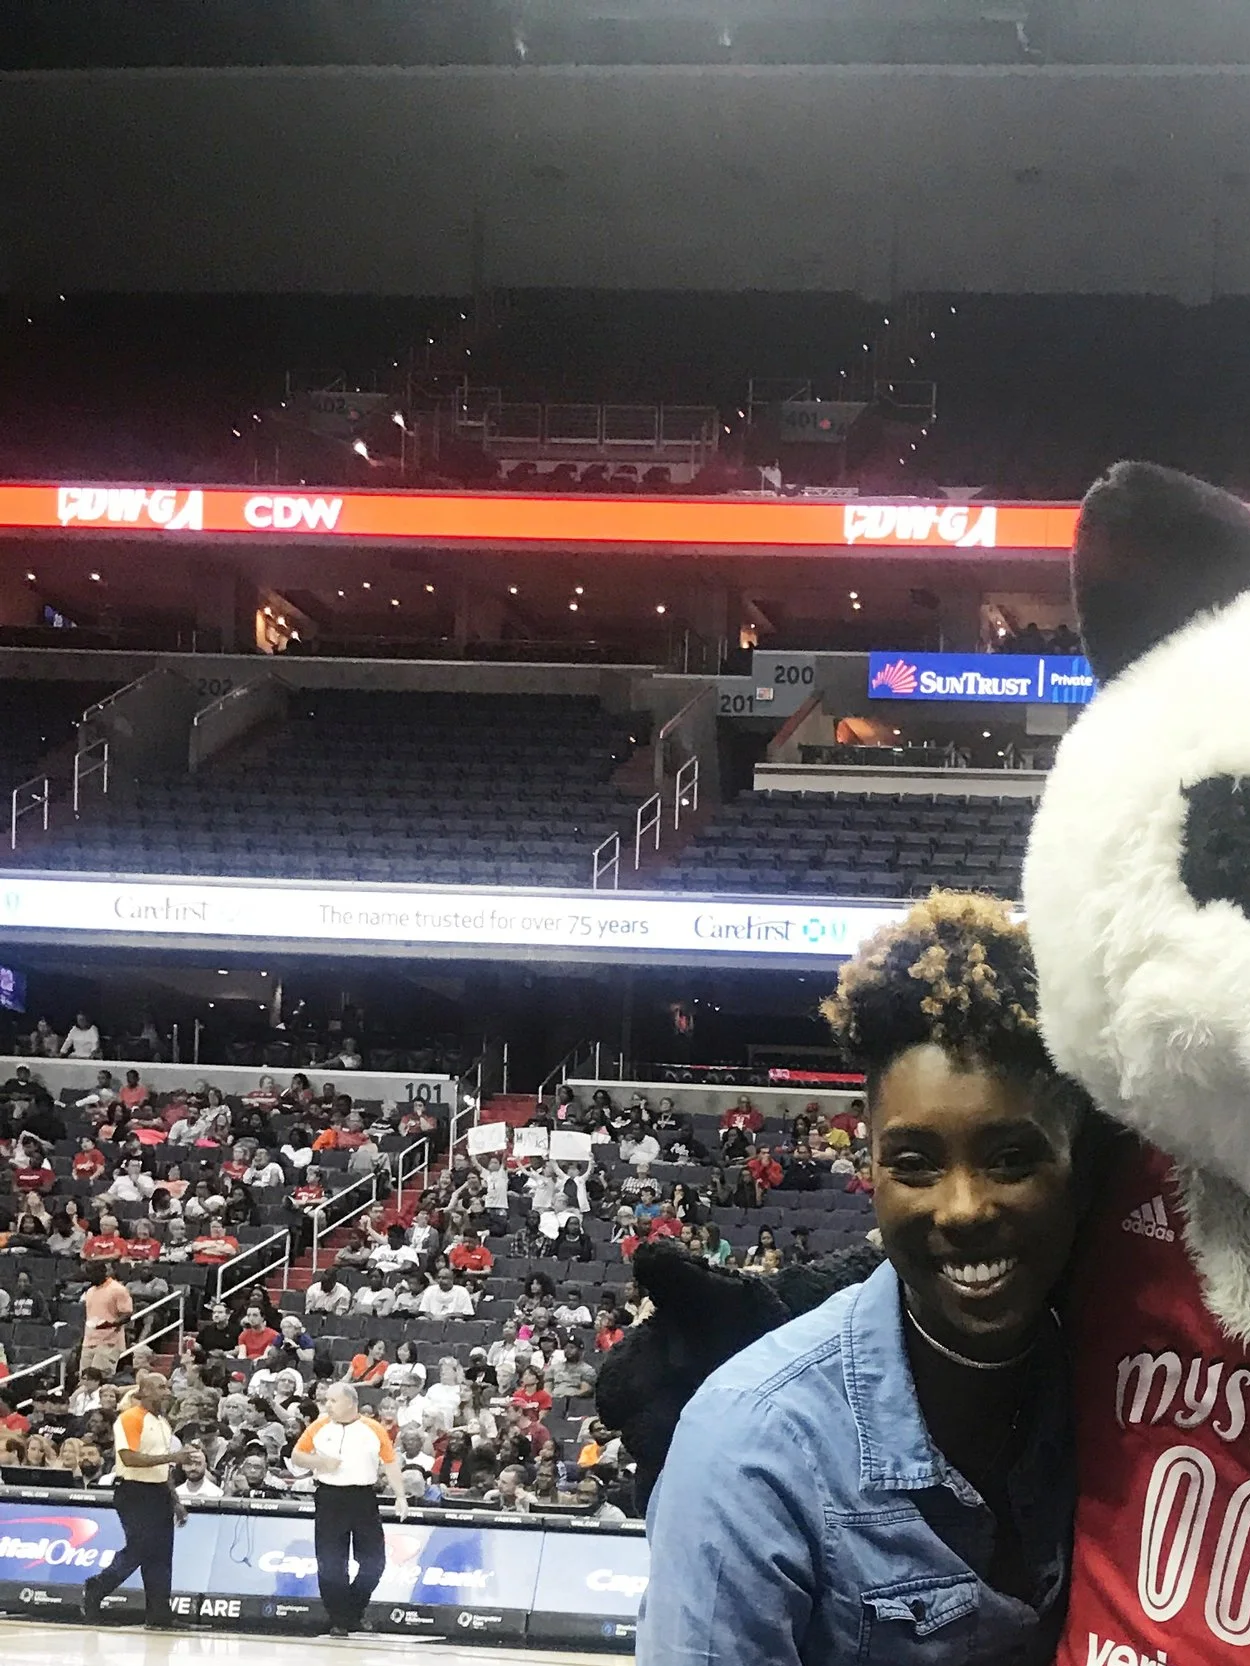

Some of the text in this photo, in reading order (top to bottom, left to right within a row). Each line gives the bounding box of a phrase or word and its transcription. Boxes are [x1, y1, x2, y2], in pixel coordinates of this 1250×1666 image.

[244, 497, 342, 529] CDW
[774, 666, 814, 685] 200
[1050, 672, 1093, 687] Private
[720, 695, 754, 713] 201
[319, 904, 649, 938] The name trusted for over 75 years
[405, 1083, 442, 1104] 101
[1121, 1217, 1175, 1243] adidas
[45, 1539, 98, 1567] One
[200, 1599, 241, 1618] ARE
